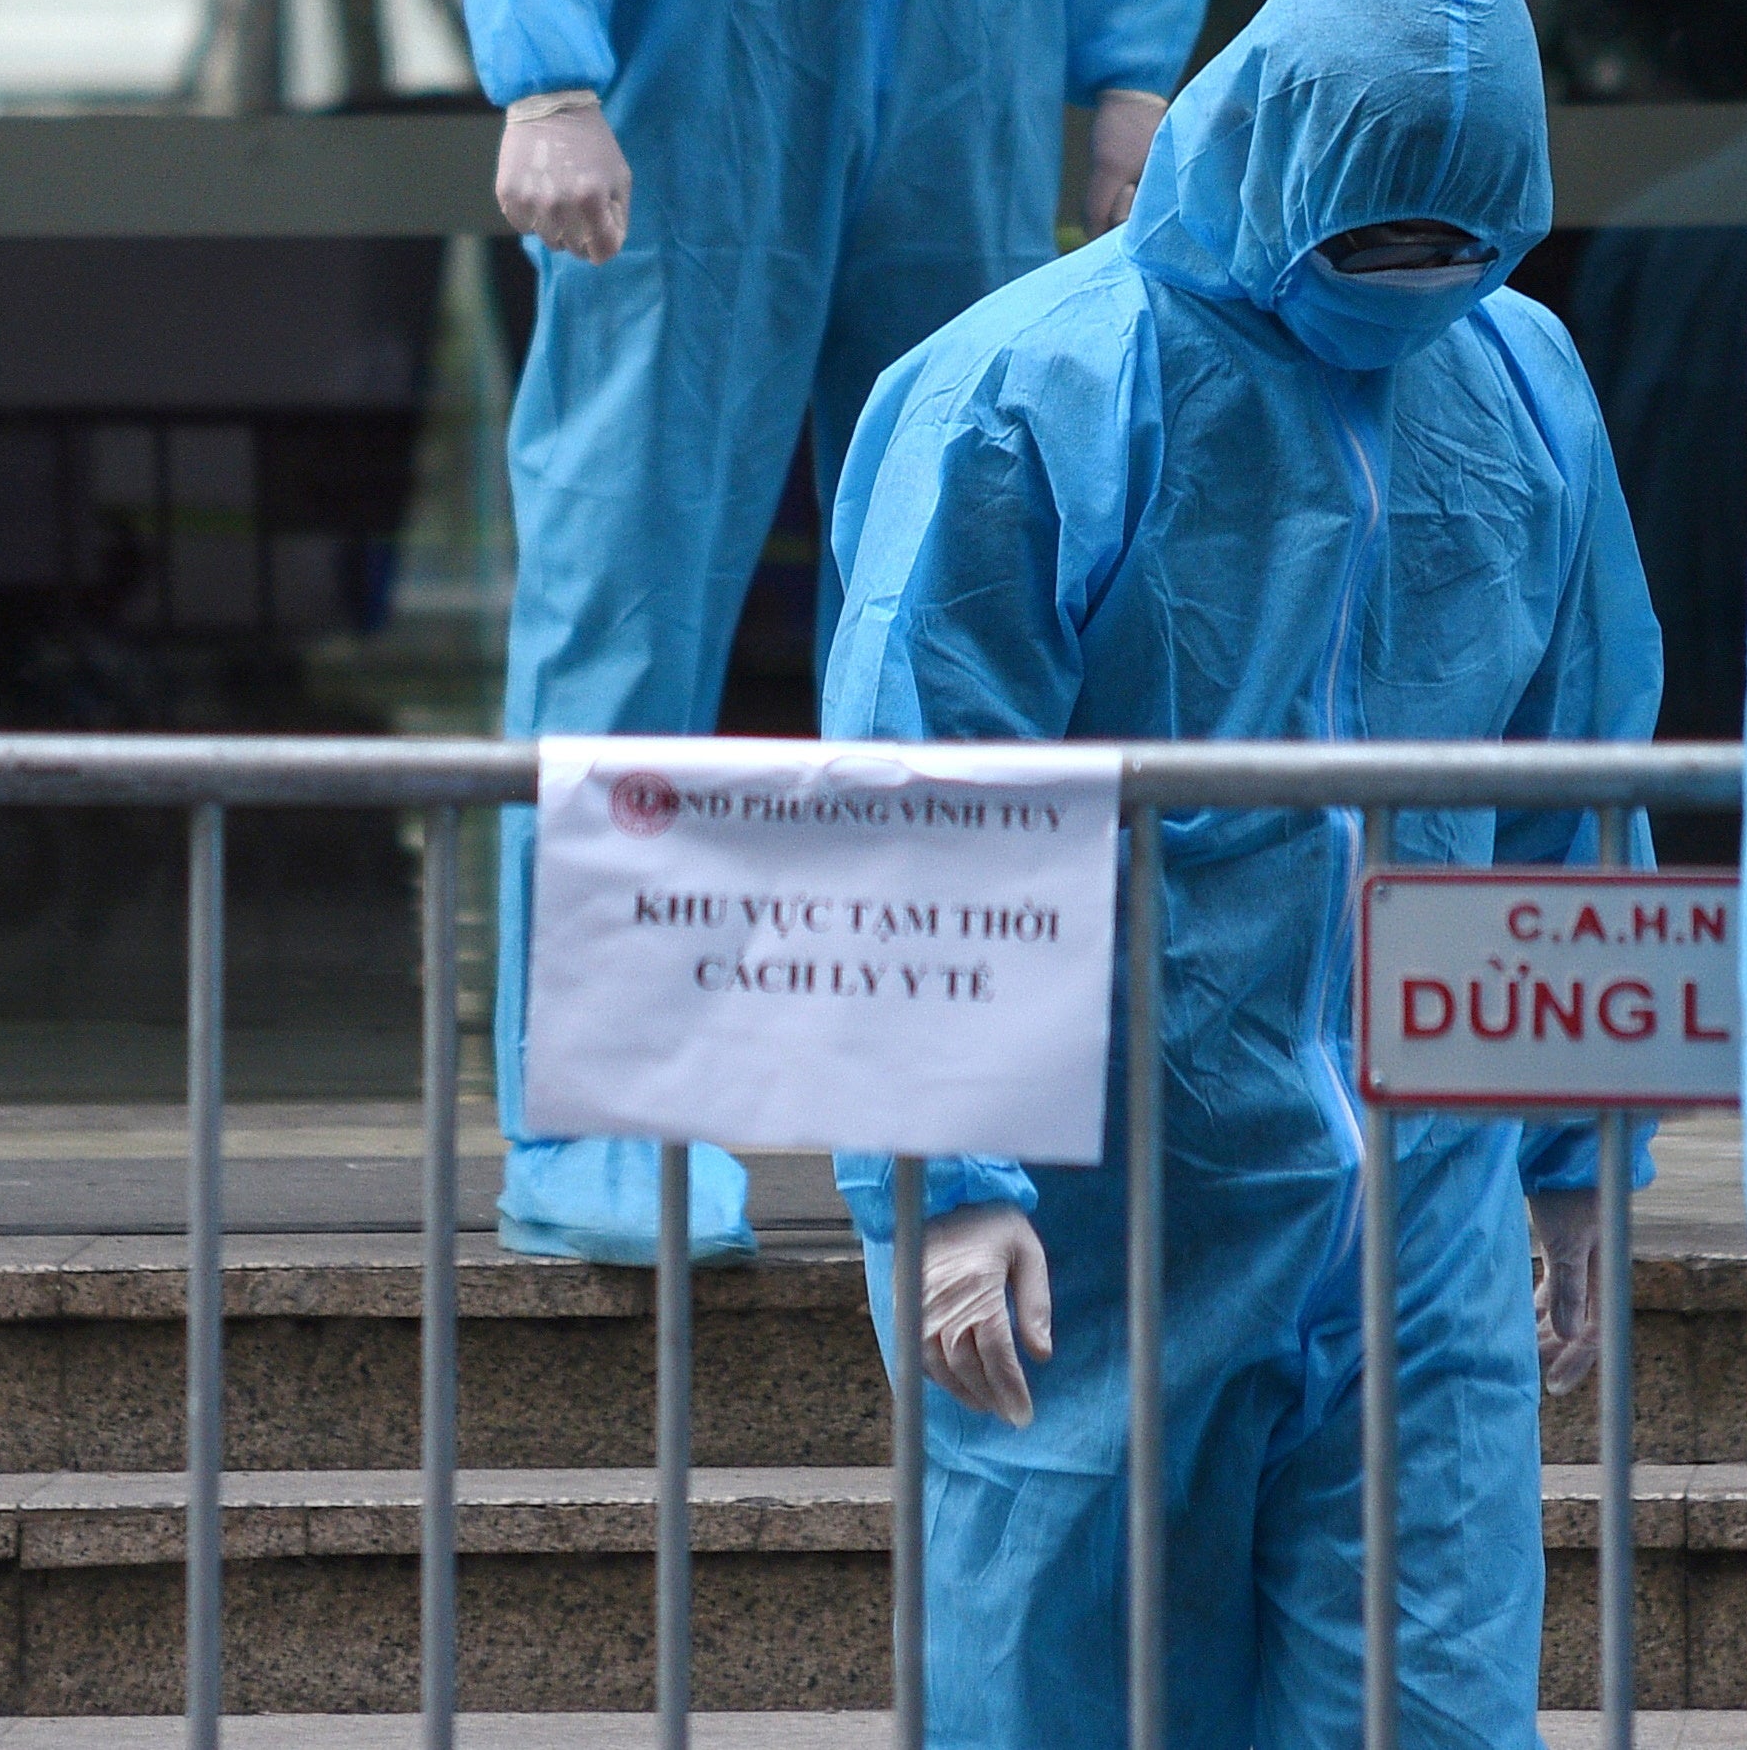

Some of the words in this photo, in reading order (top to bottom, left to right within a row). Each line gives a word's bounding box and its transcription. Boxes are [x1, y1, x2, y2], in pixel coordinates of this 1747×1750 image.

[999, 800, 1068, 835] TUY
[633, 891, 728, 930] KHU
[740, 893, 833, 940] VỰC
[846, 897, 940, 945] TẠM
[952, 898, 1061, 945] THỜI
[1506, 900, 1728, 945] C.A.H.N
[693, 945, 817, 995] CÁCH
[830, 960, 889, 998] LY
[898, 962, 933, 999] Y
[944, 956, 996, 1004] TẾ
[1400, 954, 1659, 1043] DỪNG
